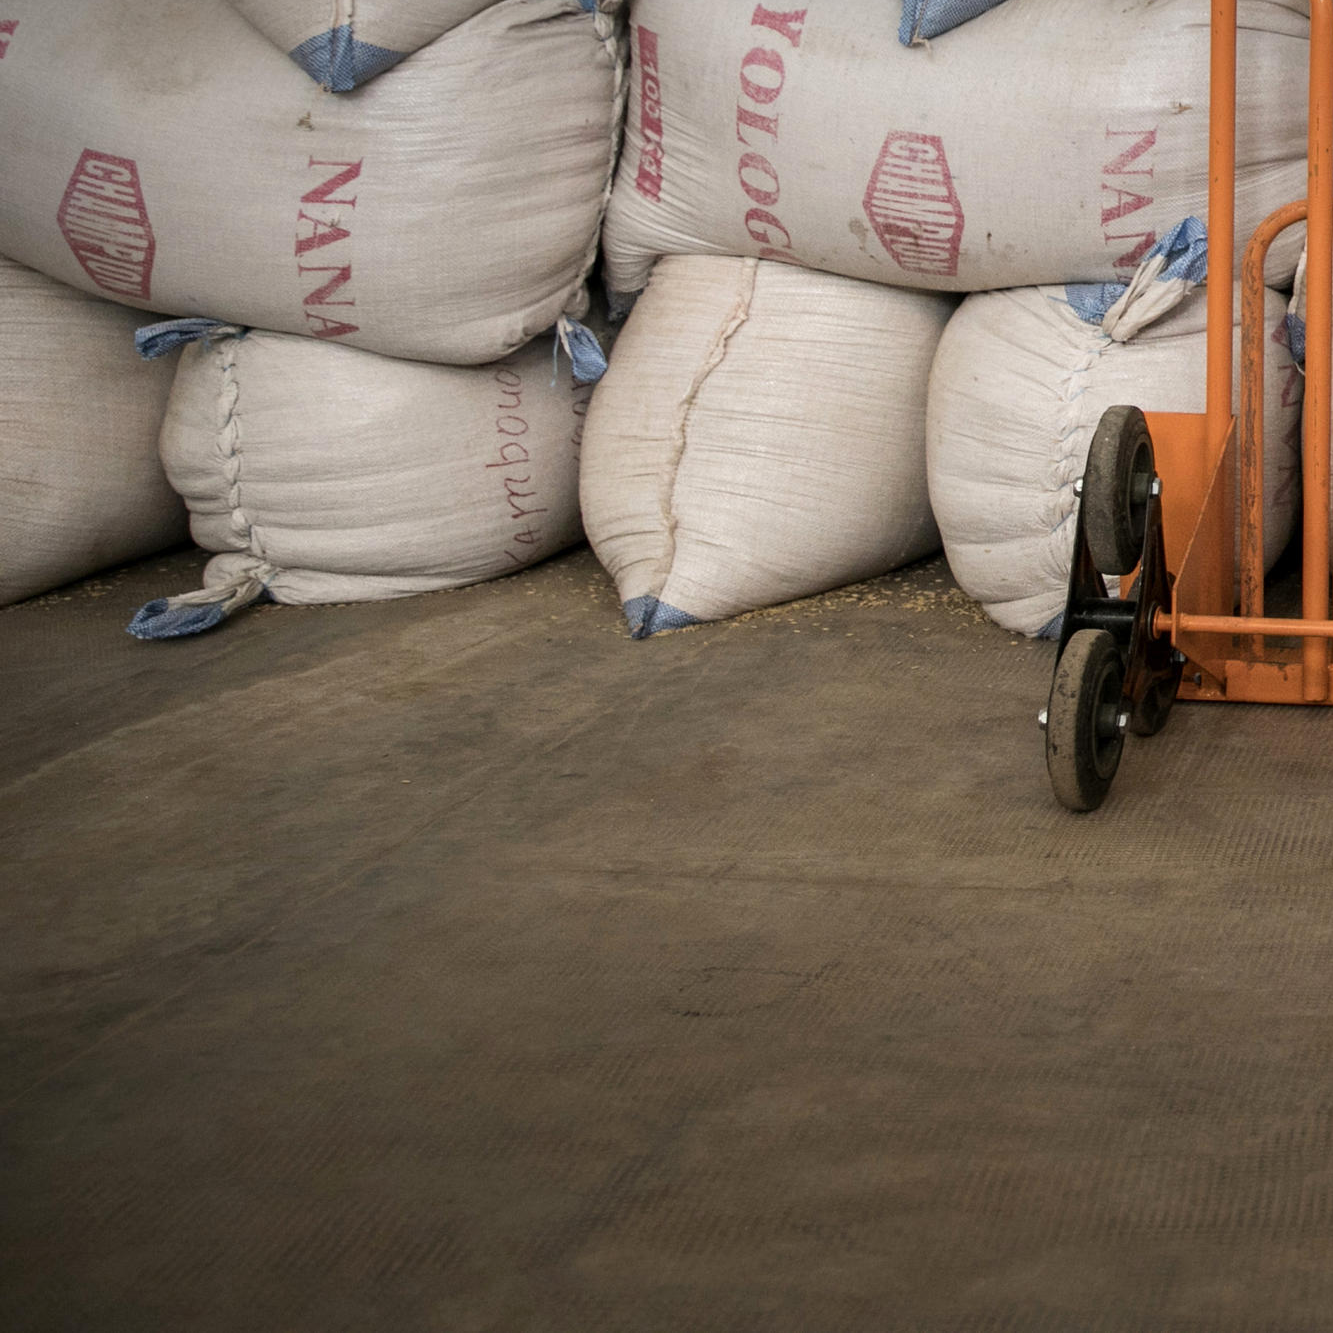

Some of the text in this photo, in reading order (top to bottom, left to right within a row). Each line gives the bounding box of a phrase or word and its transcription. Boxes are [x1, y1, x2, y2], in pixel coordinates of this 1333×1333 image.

[642, 61, 661, 121] 100
[60, 152, 152, 297] CHAMPION
[294, 155, 362, 338] NANA
[866, 135, 960, 274] CHAMPION
